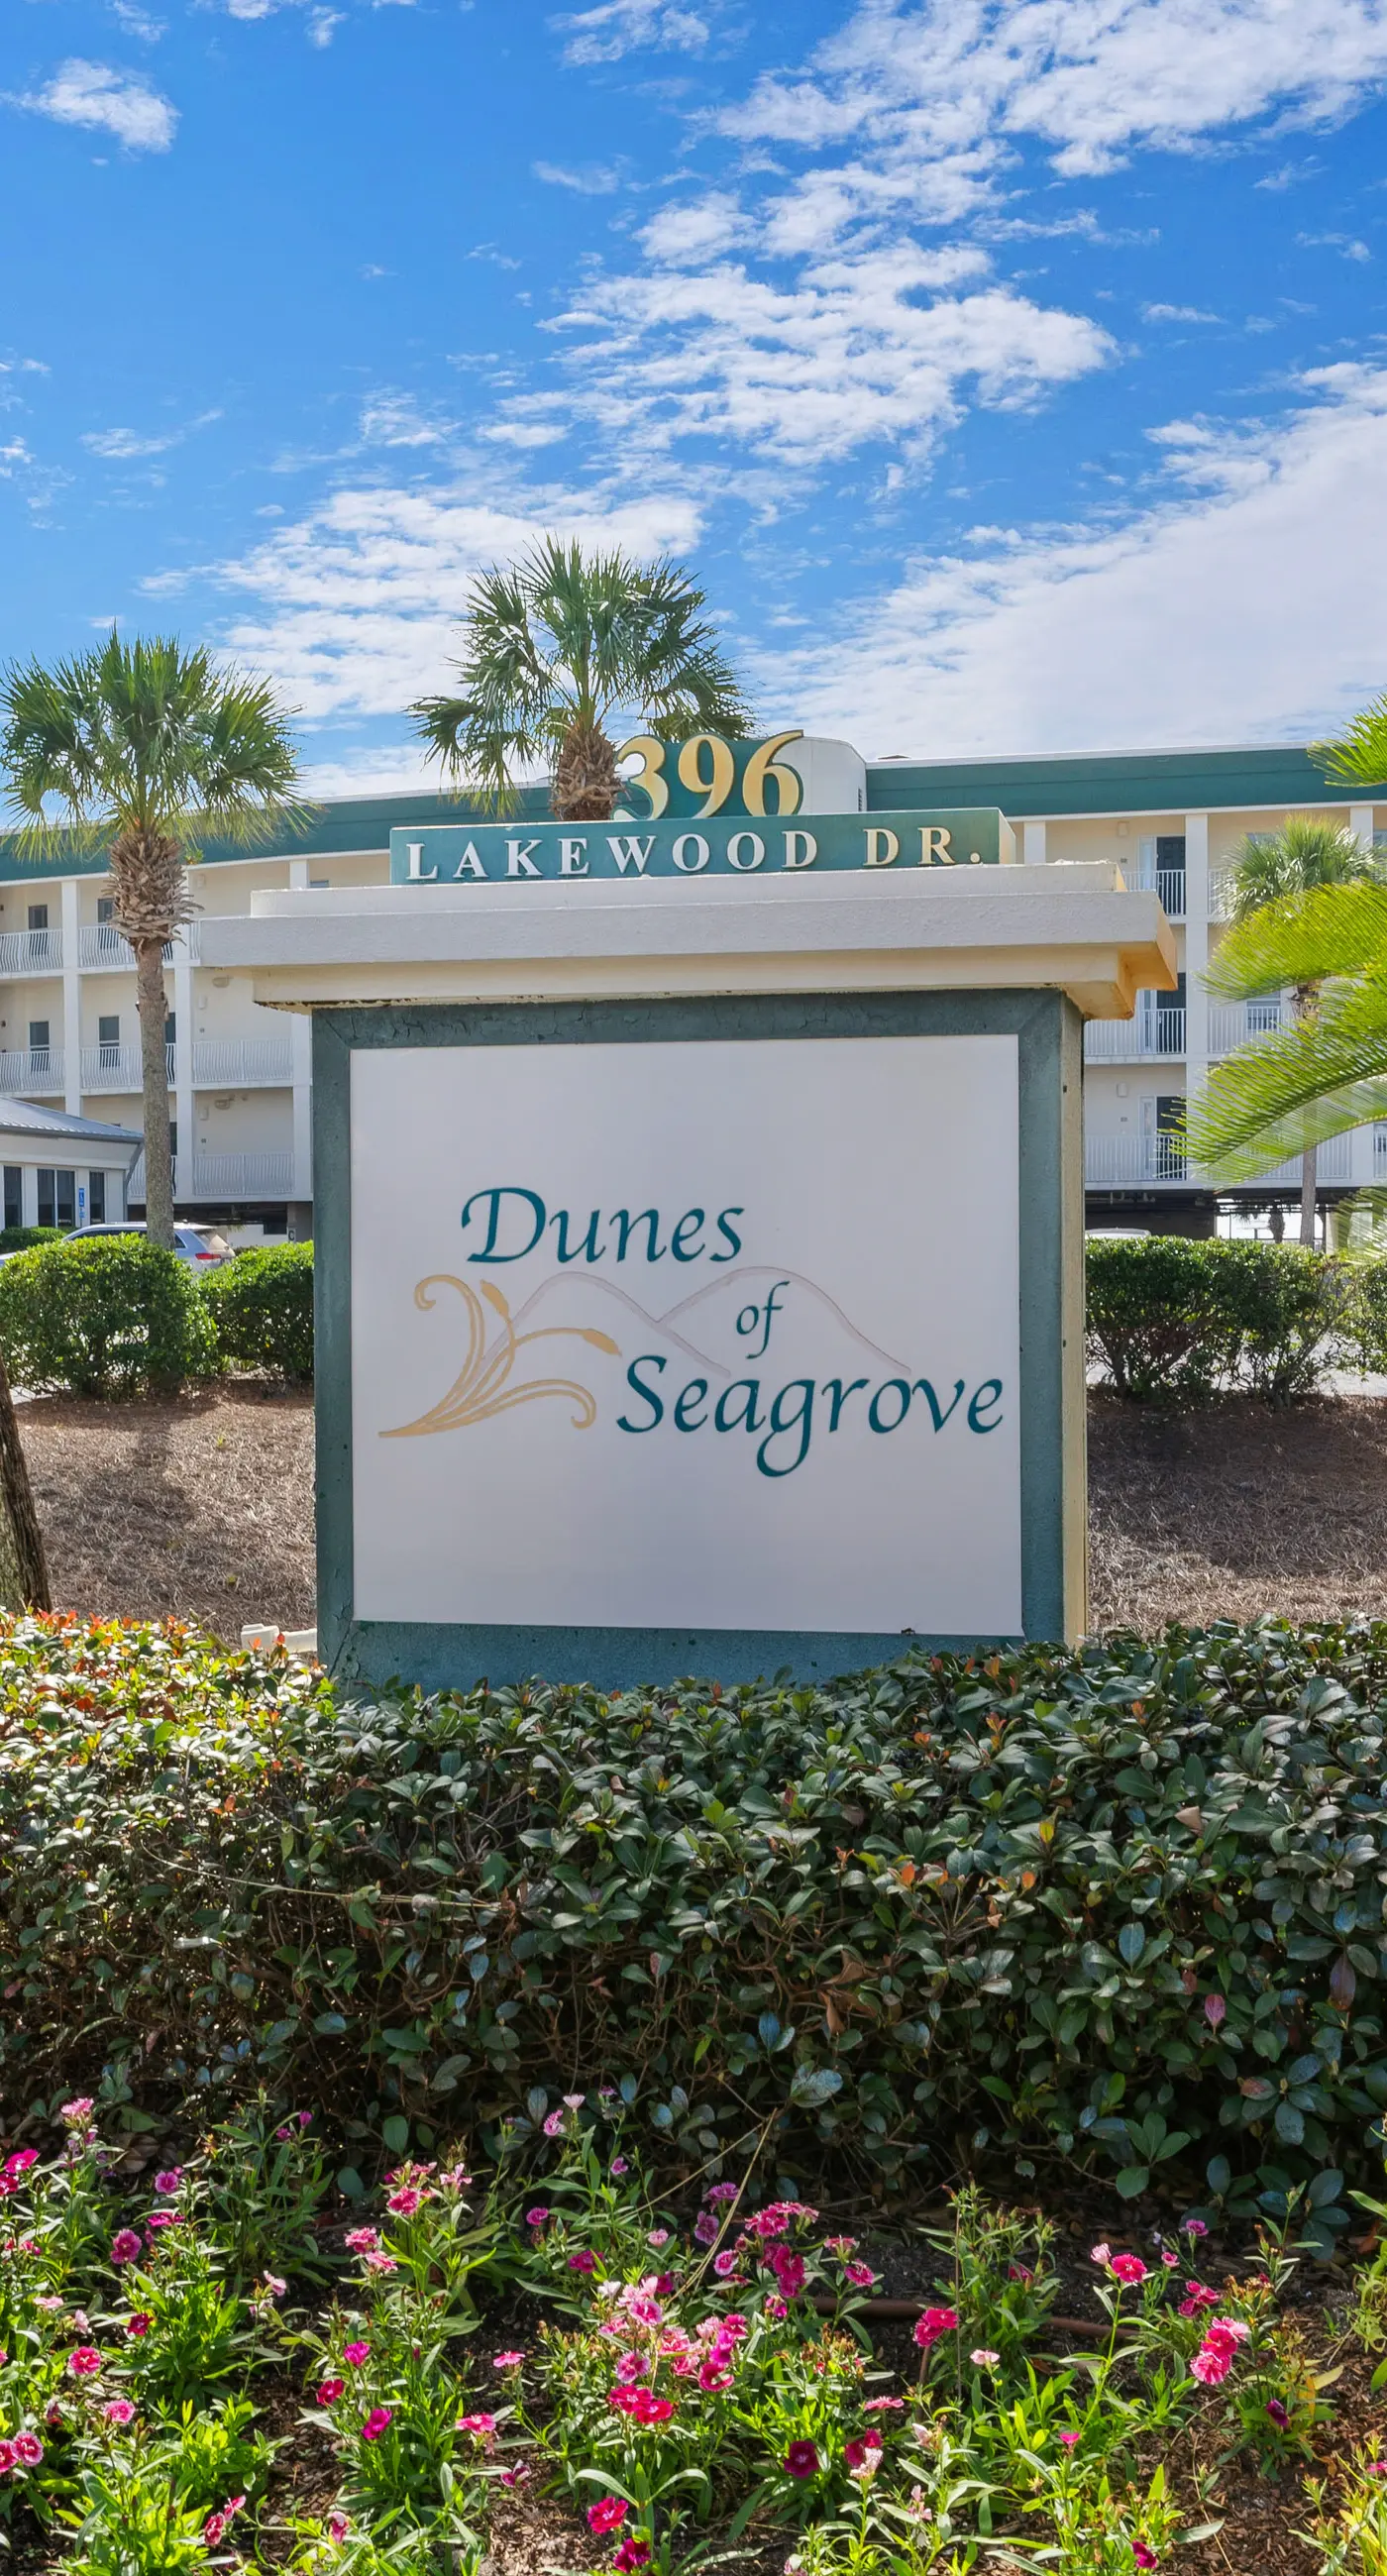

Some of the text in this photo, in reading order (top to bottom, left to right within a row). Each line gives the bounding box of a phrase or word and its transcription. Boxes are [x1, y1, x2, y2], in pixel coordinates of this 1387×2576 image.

[613, 730, 803, 819] 396
[405, 826, 984, 881] LAKEWOOD DR.
[461, 1187, 745, 1264] Dunes
[735, 1280, 791, 1360] of
[615, 1354, 1004, 1478] Seagrove
